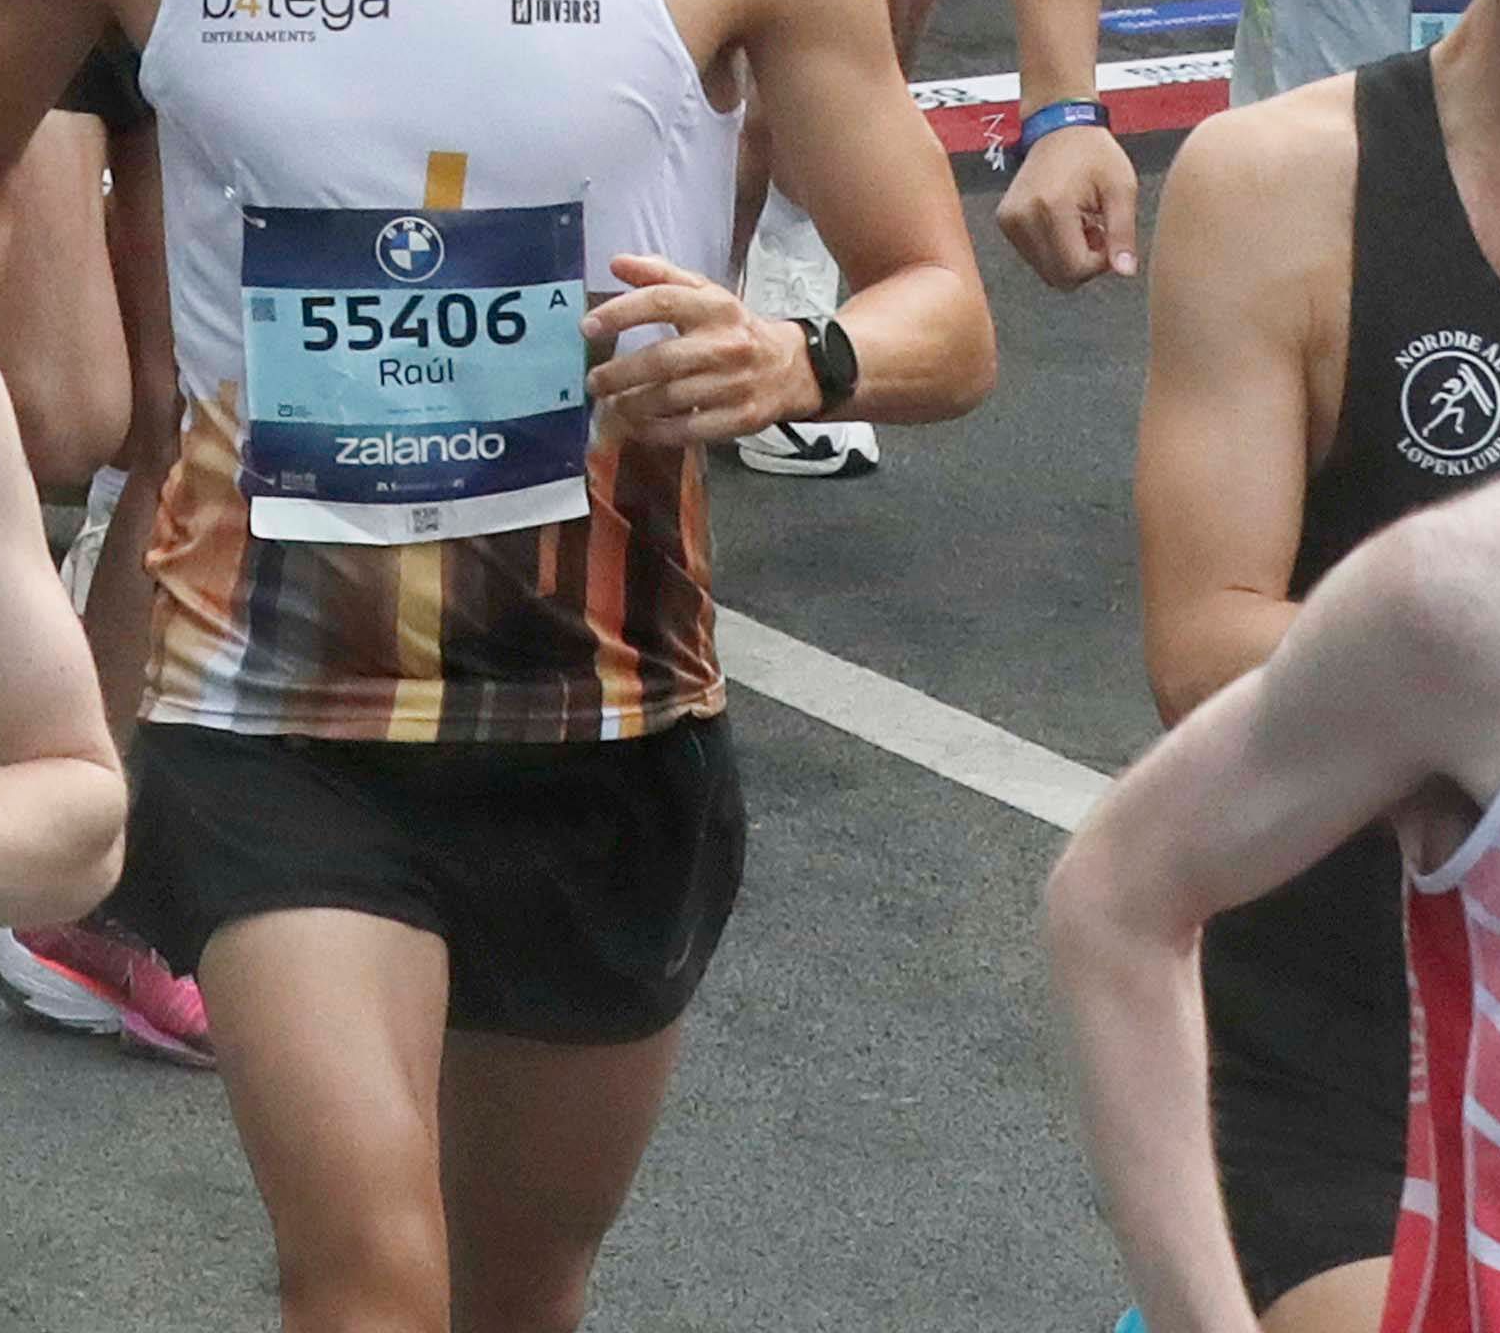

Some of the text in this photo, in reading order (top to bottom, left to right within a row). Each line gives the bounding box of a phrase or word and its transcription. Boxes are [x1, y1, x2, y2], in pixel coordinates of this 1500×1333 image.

[200, 30, 317, 45] ENTRENAMENTS
[548, 289, 569, 310] A
[299, 288, 528, 354] 55406
[1394, 330, 1483, 371] NORDRE
[378, 354, 456, 387] Raúl
[334, 426, 507, 467] zalando
